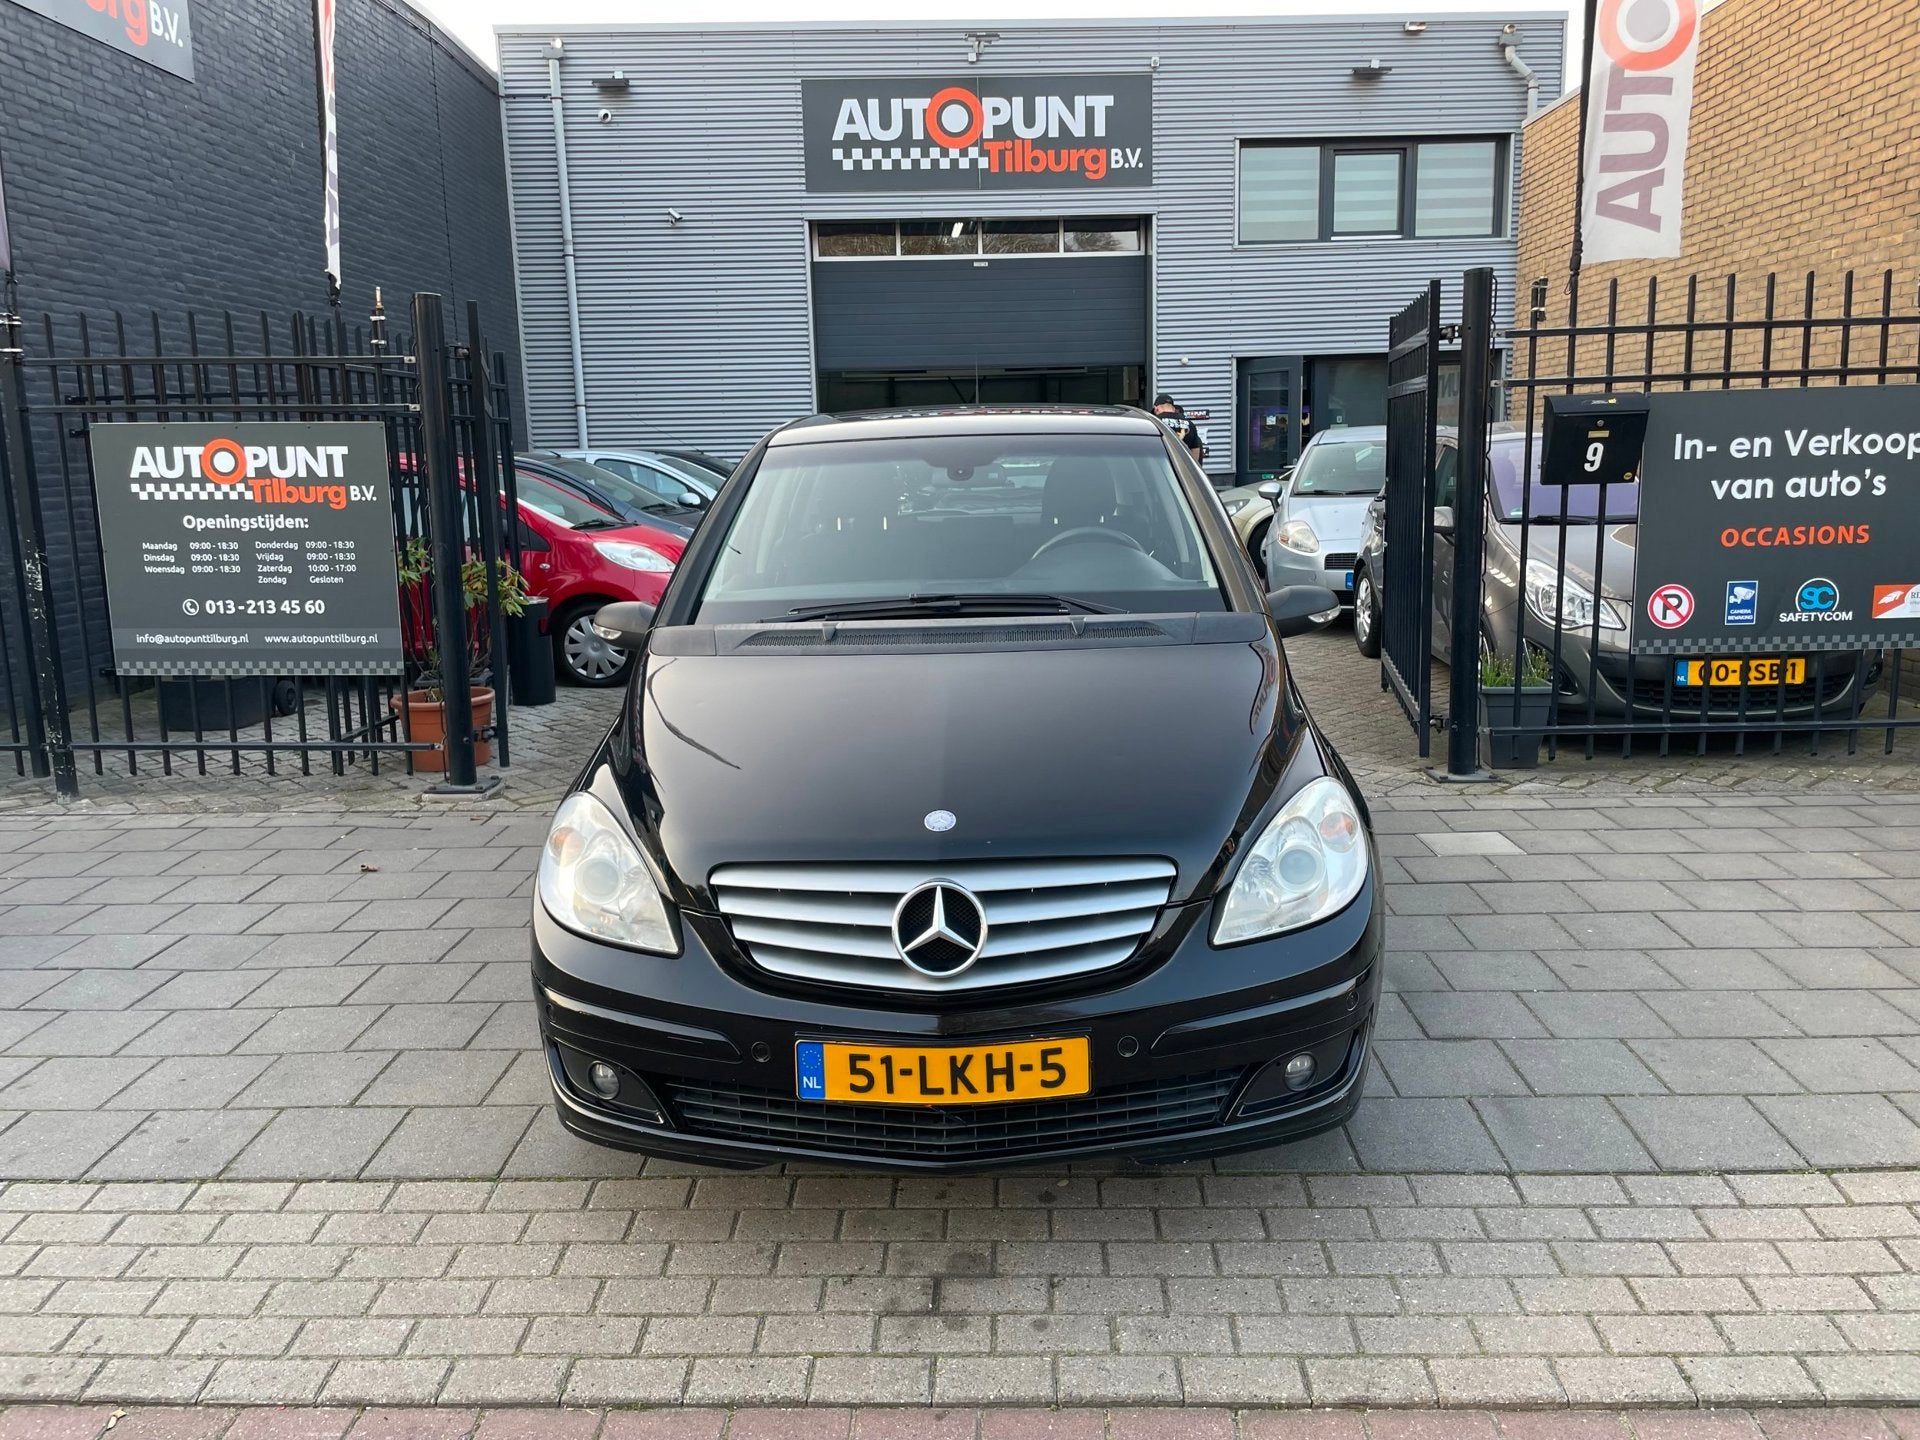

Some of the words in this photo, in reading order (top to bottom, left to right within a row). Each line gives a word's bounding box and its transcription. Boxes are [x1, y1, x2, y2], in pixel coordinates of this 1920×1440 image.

[832, 88, 1114, 148] AUTOPUNT
[984, 139, 1107, 180] Tilburg
[1111, 148, 1144, 169] B.V.
[1674, 433, 1718, 460] In-
[1729, 436, 1772, 459] en
[1784, 428, 1920, 460] Verkoop
[130, 439, 349, 484] AUTOPUNT
[1584, 442, 1604, 472] 9
[1711, 477, 1774, 500] van
[1785, 468, 1887, 498] auto's
[247, 478, 347, 510] Tilburg
[350, 485, 377, 502] B.V.
[182, 514, 309, 532] Openingstijden:
[1720, 524, 1870, 548] OCCASIONS
[142, 542, 178, 551] Maandag
[255, 541, 299, 550] Donderdag
[305, 541, 327, 549] 09:00
[333, 541, 355, 549] 18:30
[143, 553, 175, 562] Dinsdag
[190, 553, 213, 561] 09:00
[218, 553, 240, 561] 18:30
[256, 552, 284, 562] Vrijdag
[306, 552, 328, 560] 09:00
[334, 552, 356, 560] 18:30
[144, 565, 185, 574] Woensdag
[191, 565, 214, 573] 09:00
[219, 565, 241, 573] 18:30
[257, 564, 293, 573] Zaterdag
[307, 564, 330, 572] 10:00
[335, 564, 357, 572] 17:00
[257, 575, 287, 585] Zondag
[309, 575, 344, 583] Gesloten
[280, 599, 301, 614] 45
[305, 599, 326, 614] 60
[1800, 586, 1834, 609] SC
[1779, 611, 1853, 622] SAFETYCOM
[136, 634, 249, 645] info@autopunttilburg.nl
[265, 633, 379, 645] www.autopunttilburg.nl
[1698, 662, 1796, 681] 0-SB1
[803, 1076, 822, 1089] NL
[848, 1047, 1067, 1095] 51-LKH-5
